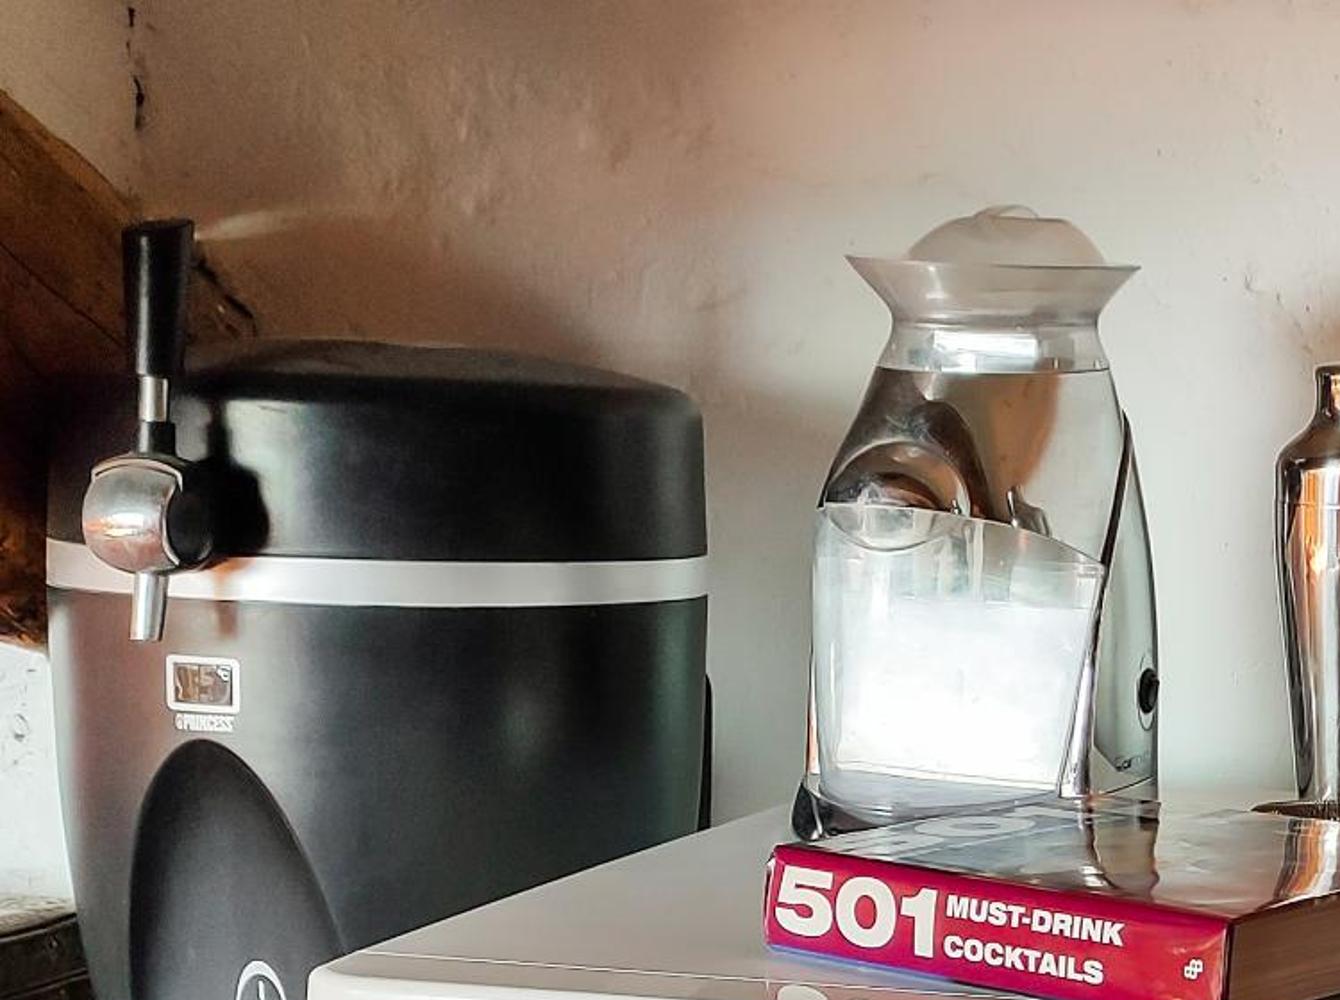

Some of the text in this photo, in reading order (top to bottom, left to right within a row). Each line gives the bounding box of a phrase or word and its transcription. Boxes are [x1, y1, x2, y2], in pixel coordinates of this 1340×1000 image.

[774, 864, 939, 959] 501
[945, 894, 1125, 948] MUST-DRINK
[942, 935, 1105, 986] COCKTAILS
